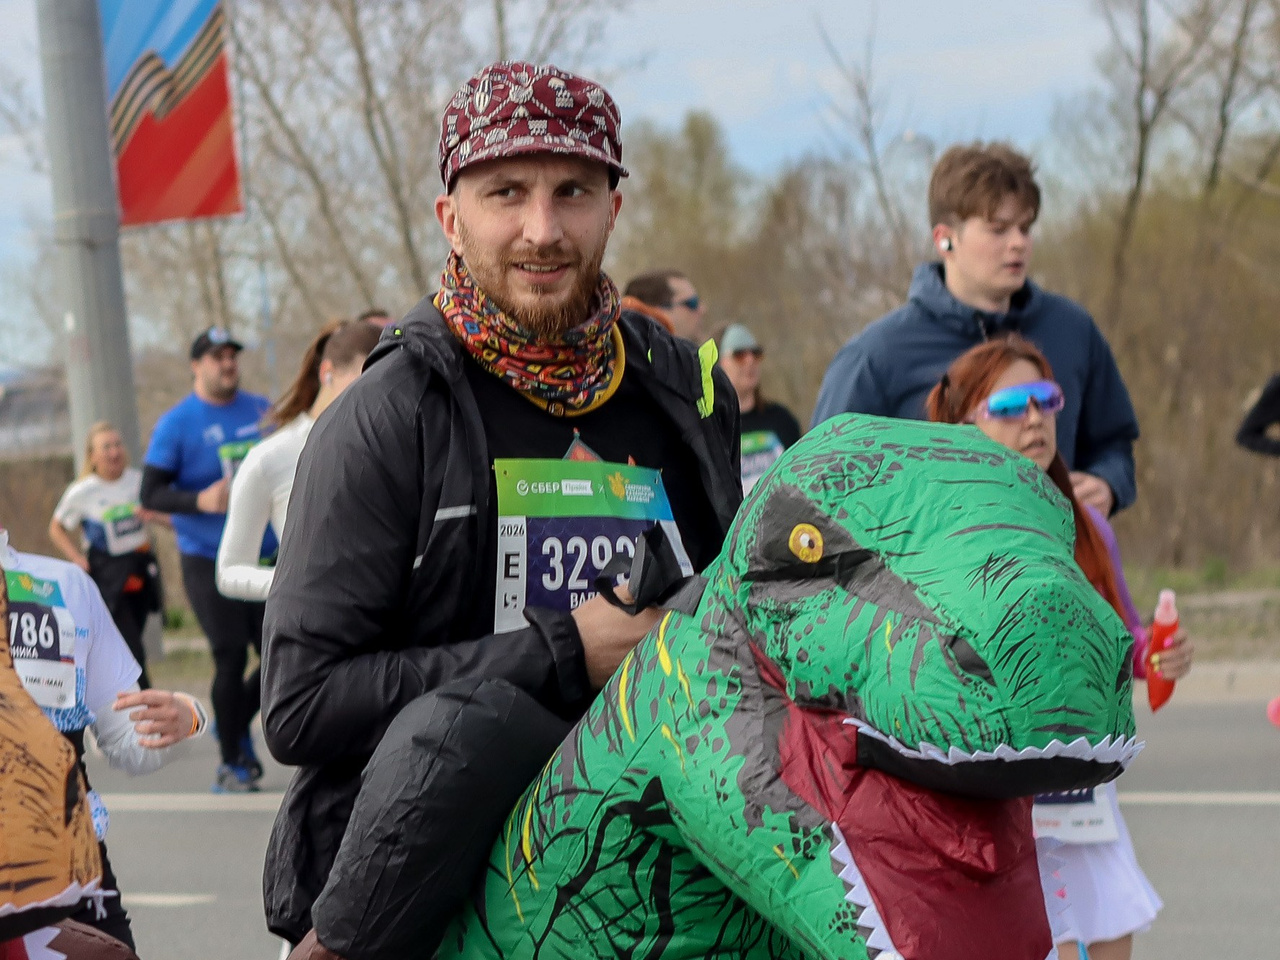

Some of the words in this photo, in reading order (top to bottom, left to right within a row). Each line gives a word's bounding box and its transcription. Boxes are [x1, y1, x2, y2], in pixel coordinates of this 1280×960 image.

[531, 481, 560, 494] СБЕР
[500, 525, 525, 536] 2026
[504, 551, 520, 579] E
